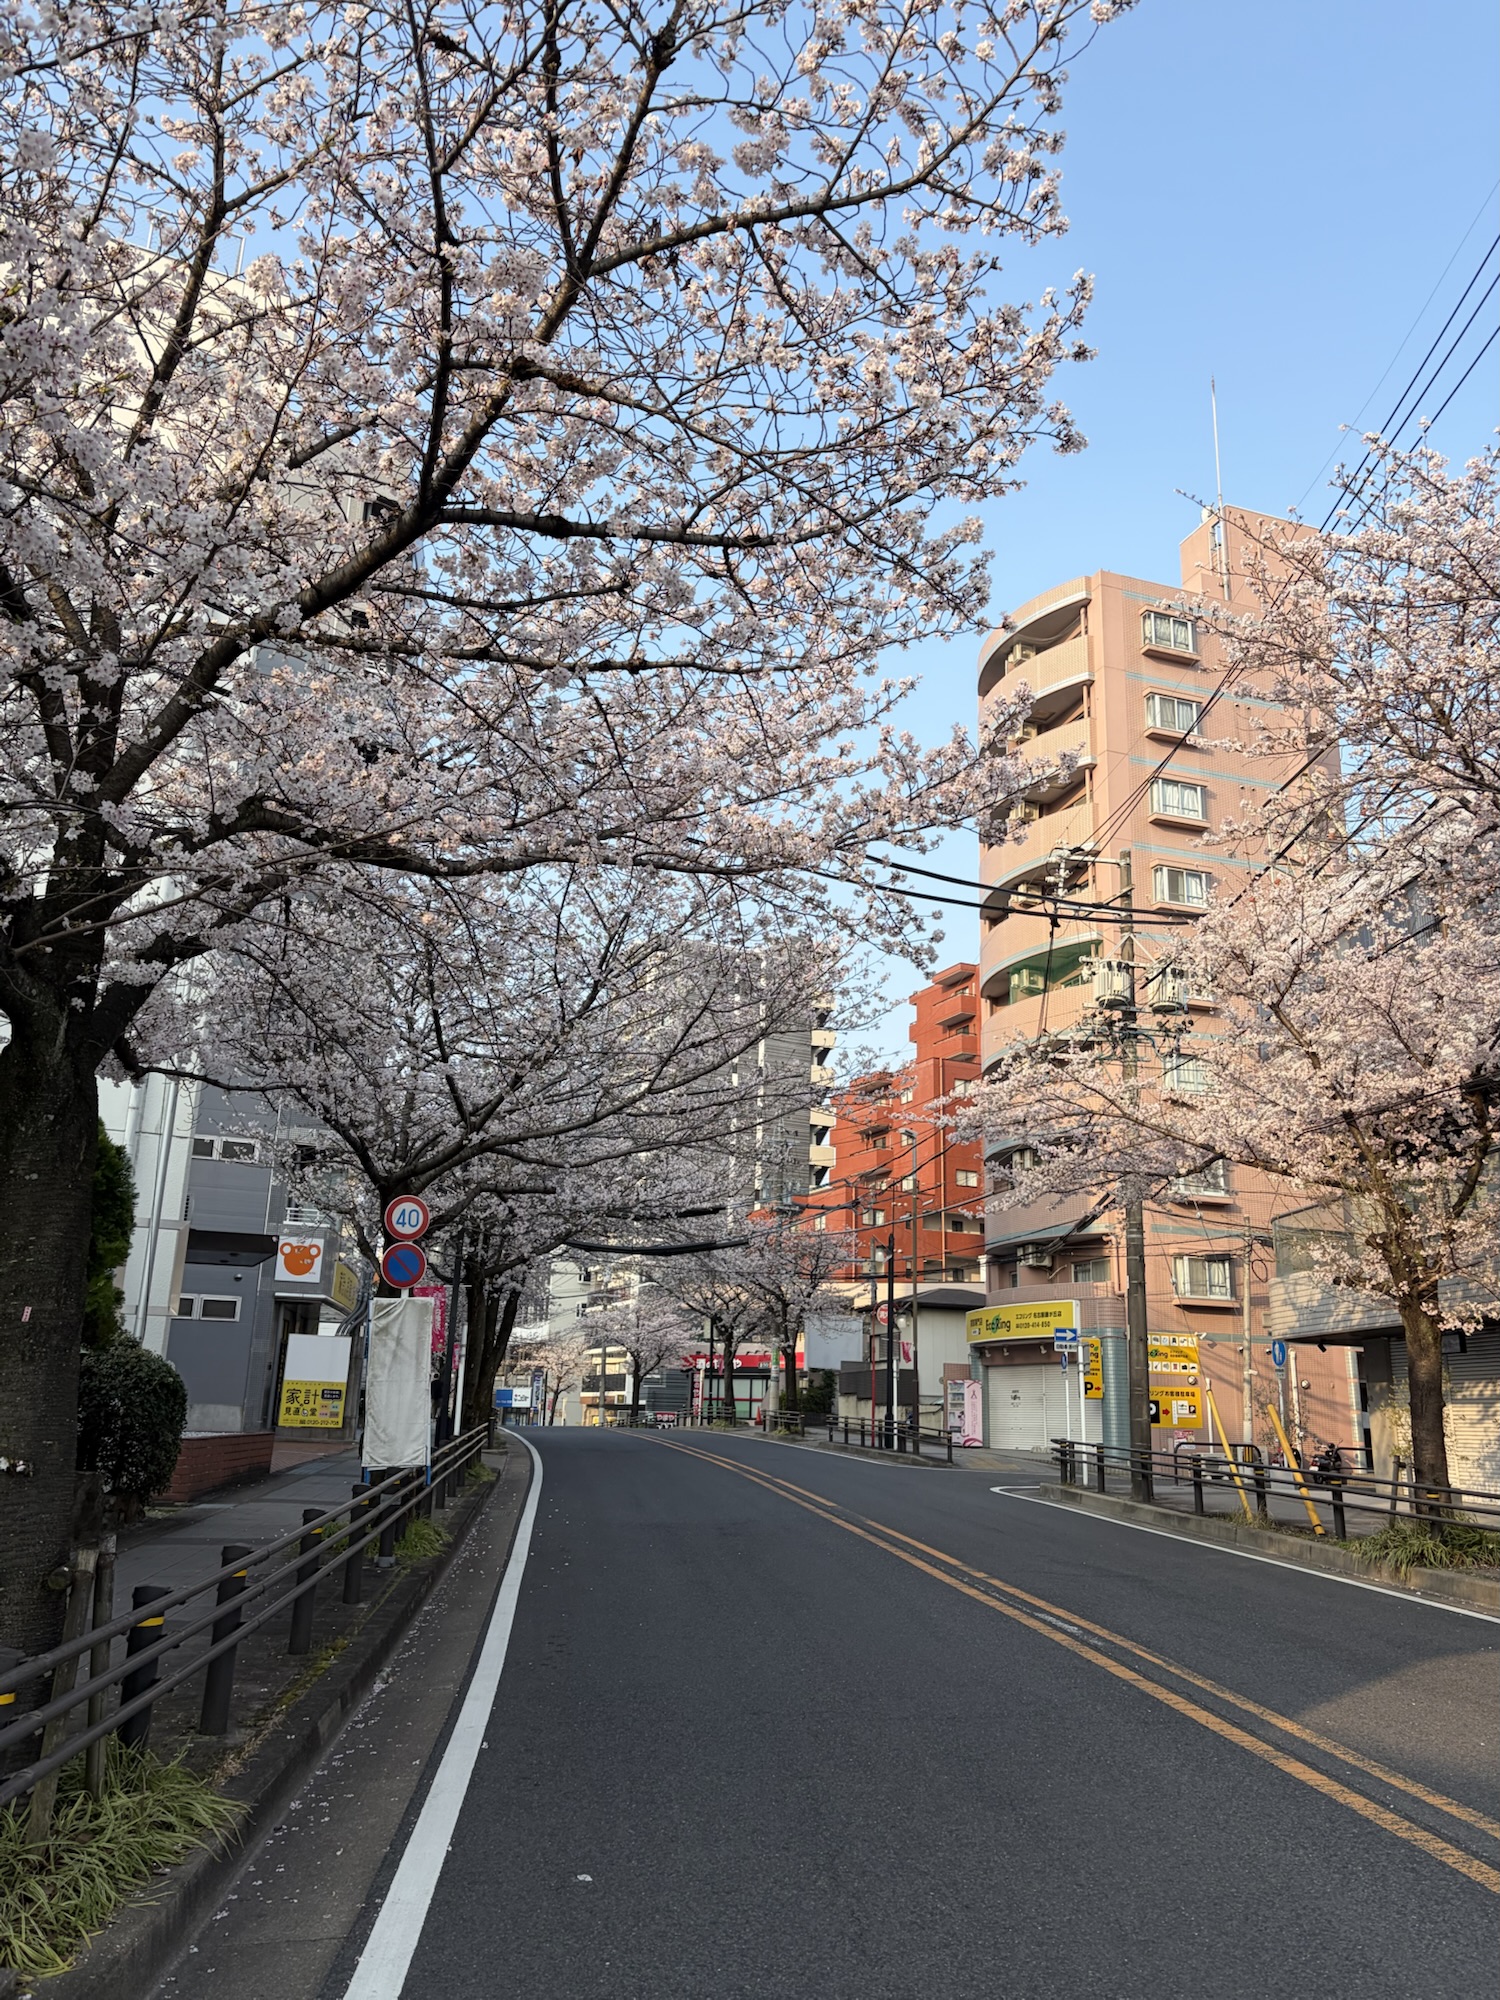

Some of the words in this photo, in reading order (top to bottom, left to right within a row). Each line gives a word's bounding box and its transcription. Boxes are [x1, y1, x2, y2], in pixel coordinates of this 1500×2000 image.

[396, 1208, 420, 1228] 40
[985, 1318, 1011, 1332] EcoRing
[1084, 1381, 1094, 1395] P
